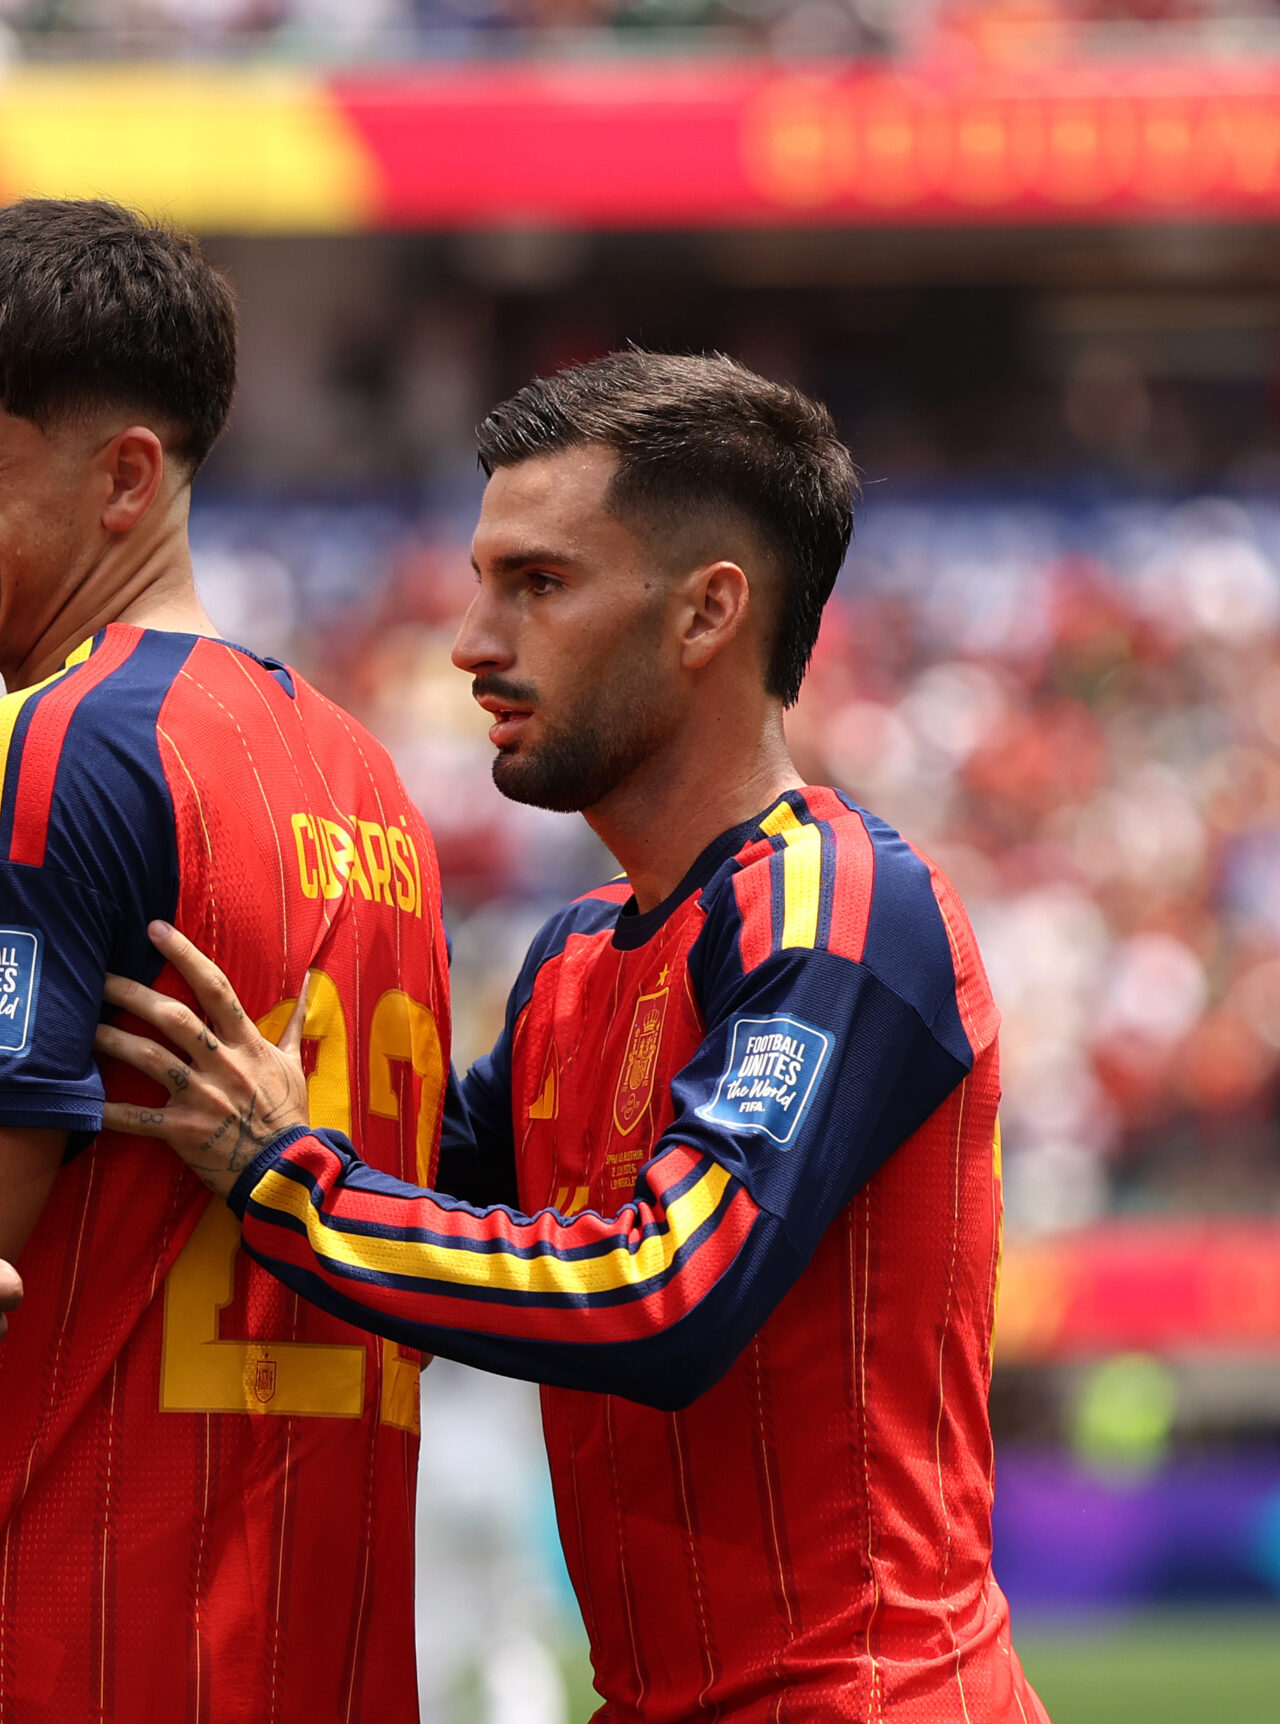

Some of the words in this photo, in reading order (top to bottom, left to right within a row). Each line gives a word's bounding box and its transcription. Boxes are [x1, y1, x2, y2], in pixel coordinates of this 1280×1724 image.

[745, 1033, 806, 1063] FOOTBALL
[737, 1052, 802, 1086] UNITES
[726, 1078, 749, 1100] the
[749, 1078, 797, 1112] World
[738, 1101, 764, 1113] FIFA
